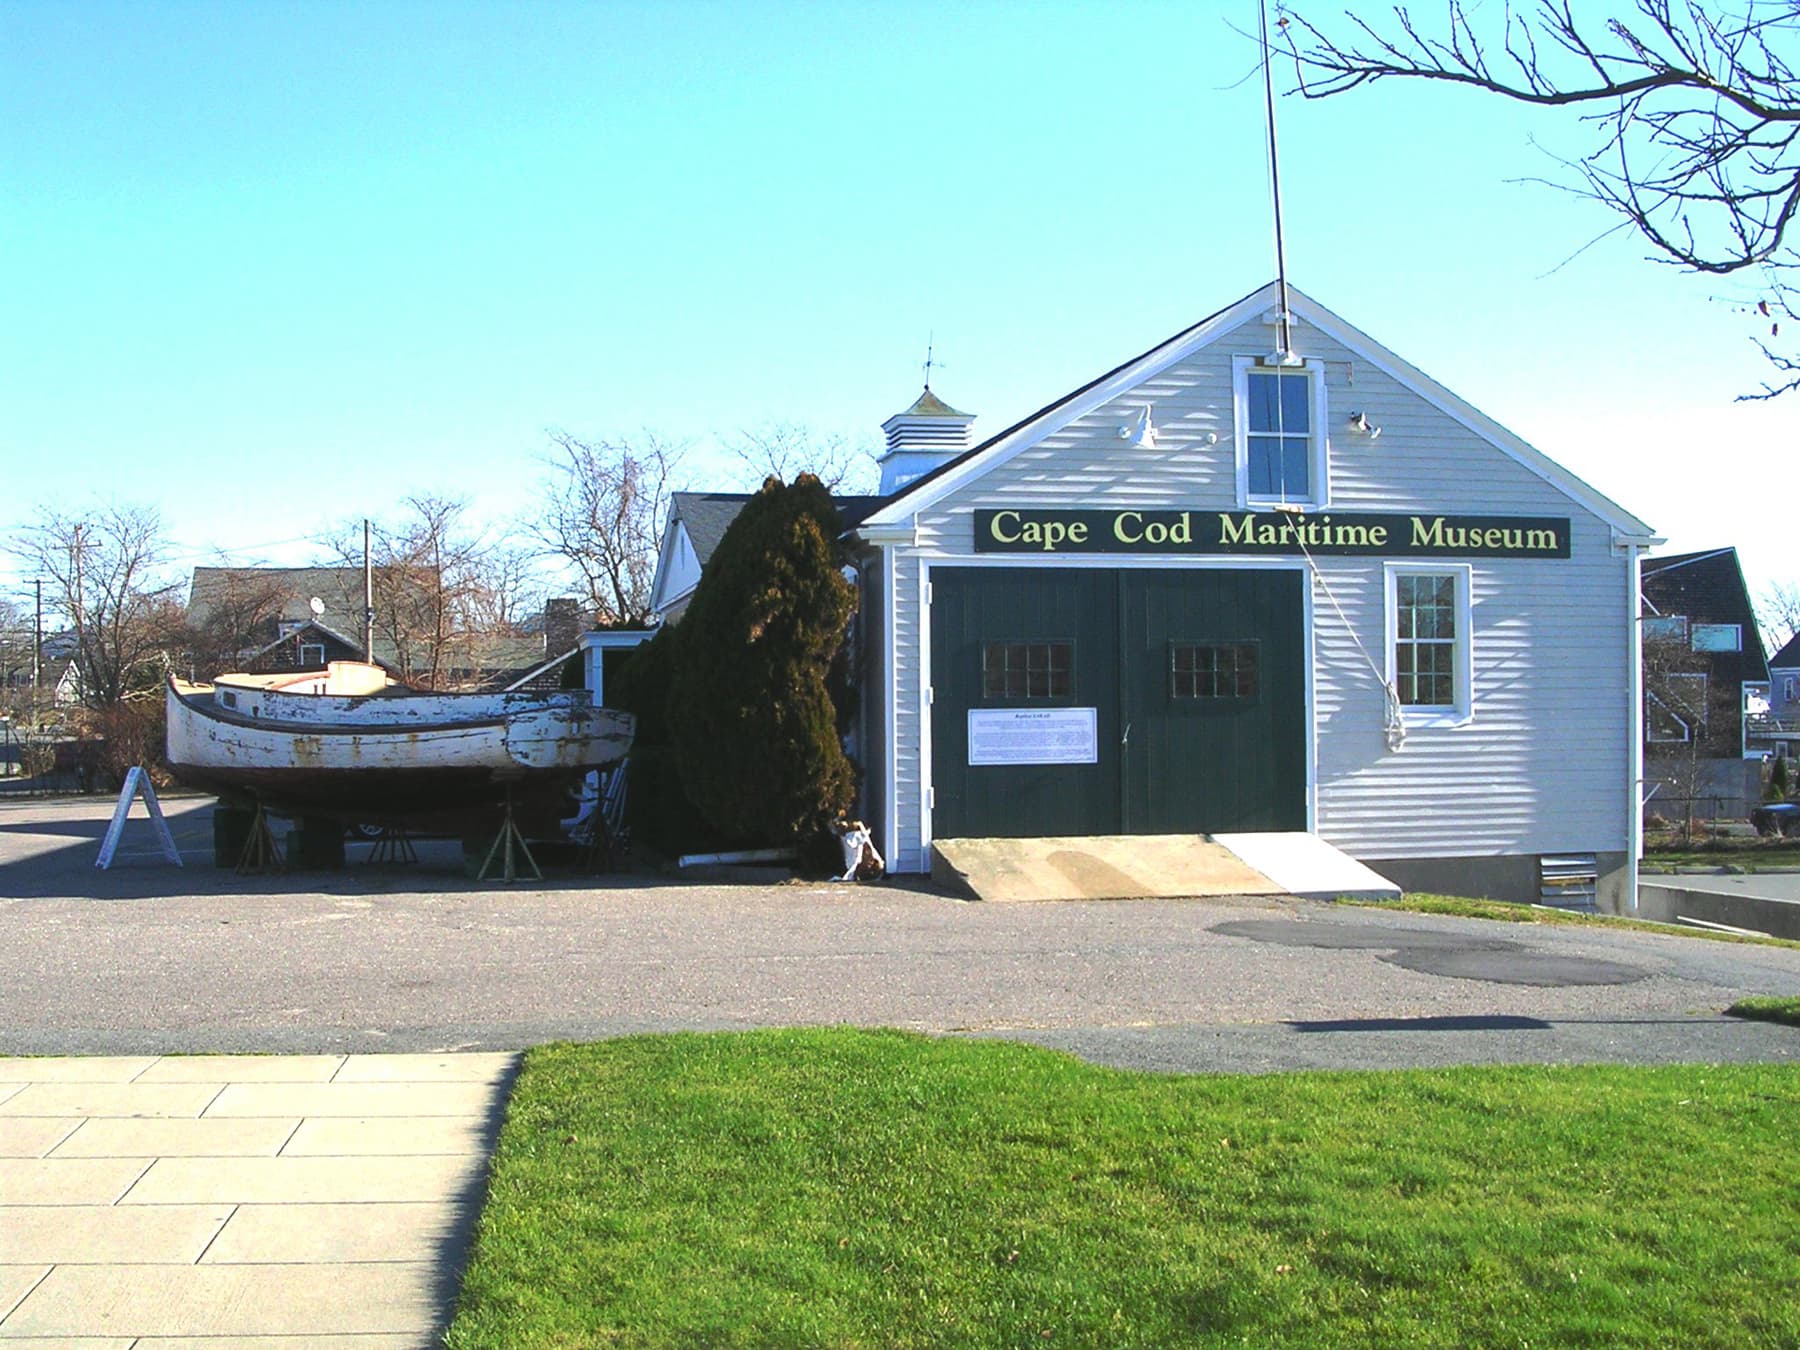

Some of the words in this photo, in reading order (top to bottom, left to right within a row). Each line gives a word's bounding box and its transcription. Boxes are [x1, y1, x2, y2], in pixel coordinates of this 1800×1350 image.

[990, 511, 1089, 552] Cape
[1114, 509, 1192, 544] Cod
[1218, 513, 1388, 547] Maritime
[1410, 517, 1559, 549] Museum
